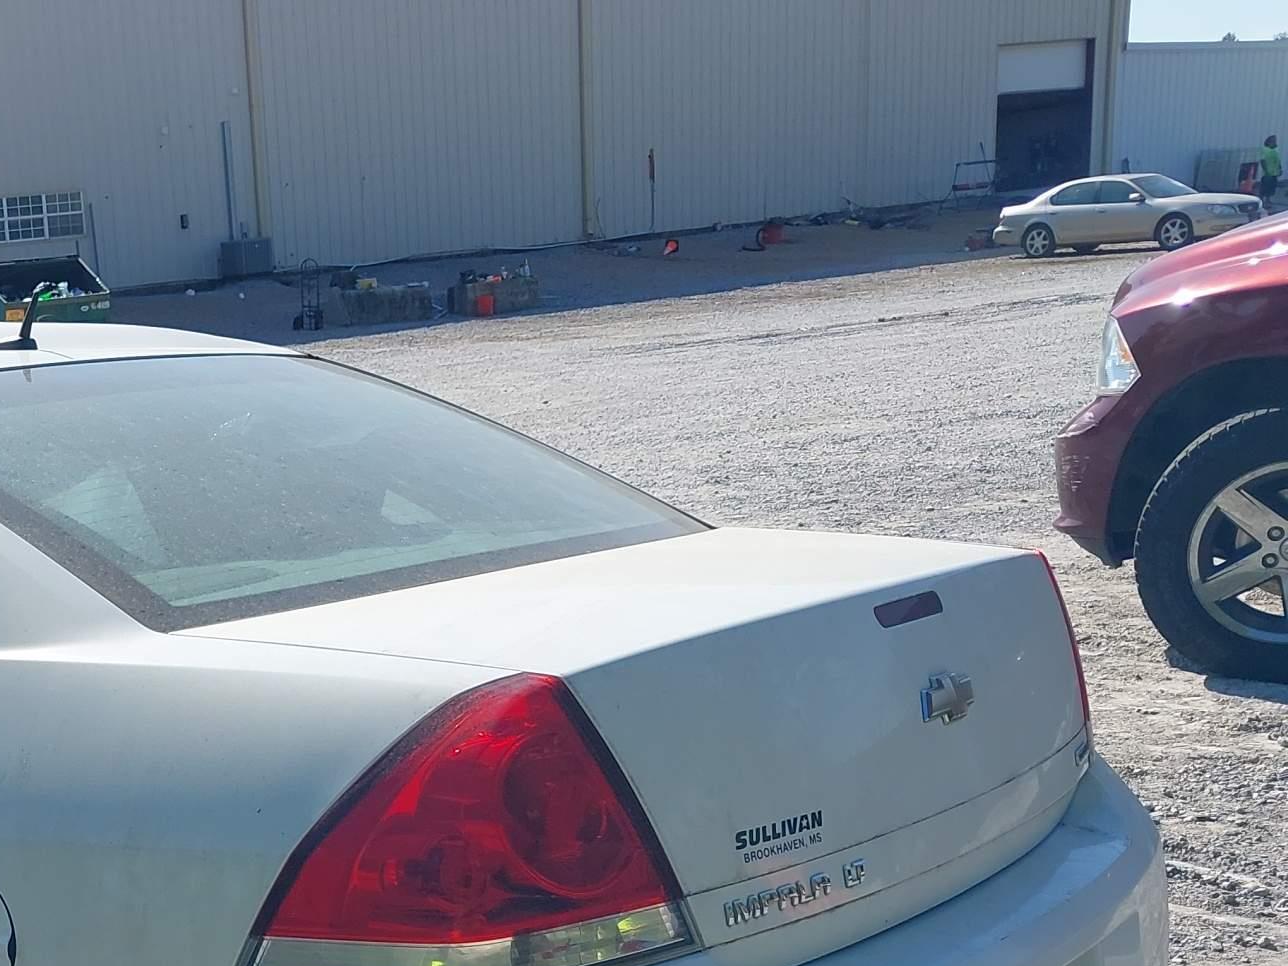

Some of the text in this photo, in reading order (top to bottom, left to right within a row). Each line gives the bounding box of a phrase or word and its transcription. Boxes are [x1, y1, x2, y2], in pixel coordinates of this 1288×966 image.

[735, 810, 823, 850] SULLIVAN
[744, 832, 823, 864] BROOKHAVEN, MS
[723, 858, 866, 927] IMPALA LT
